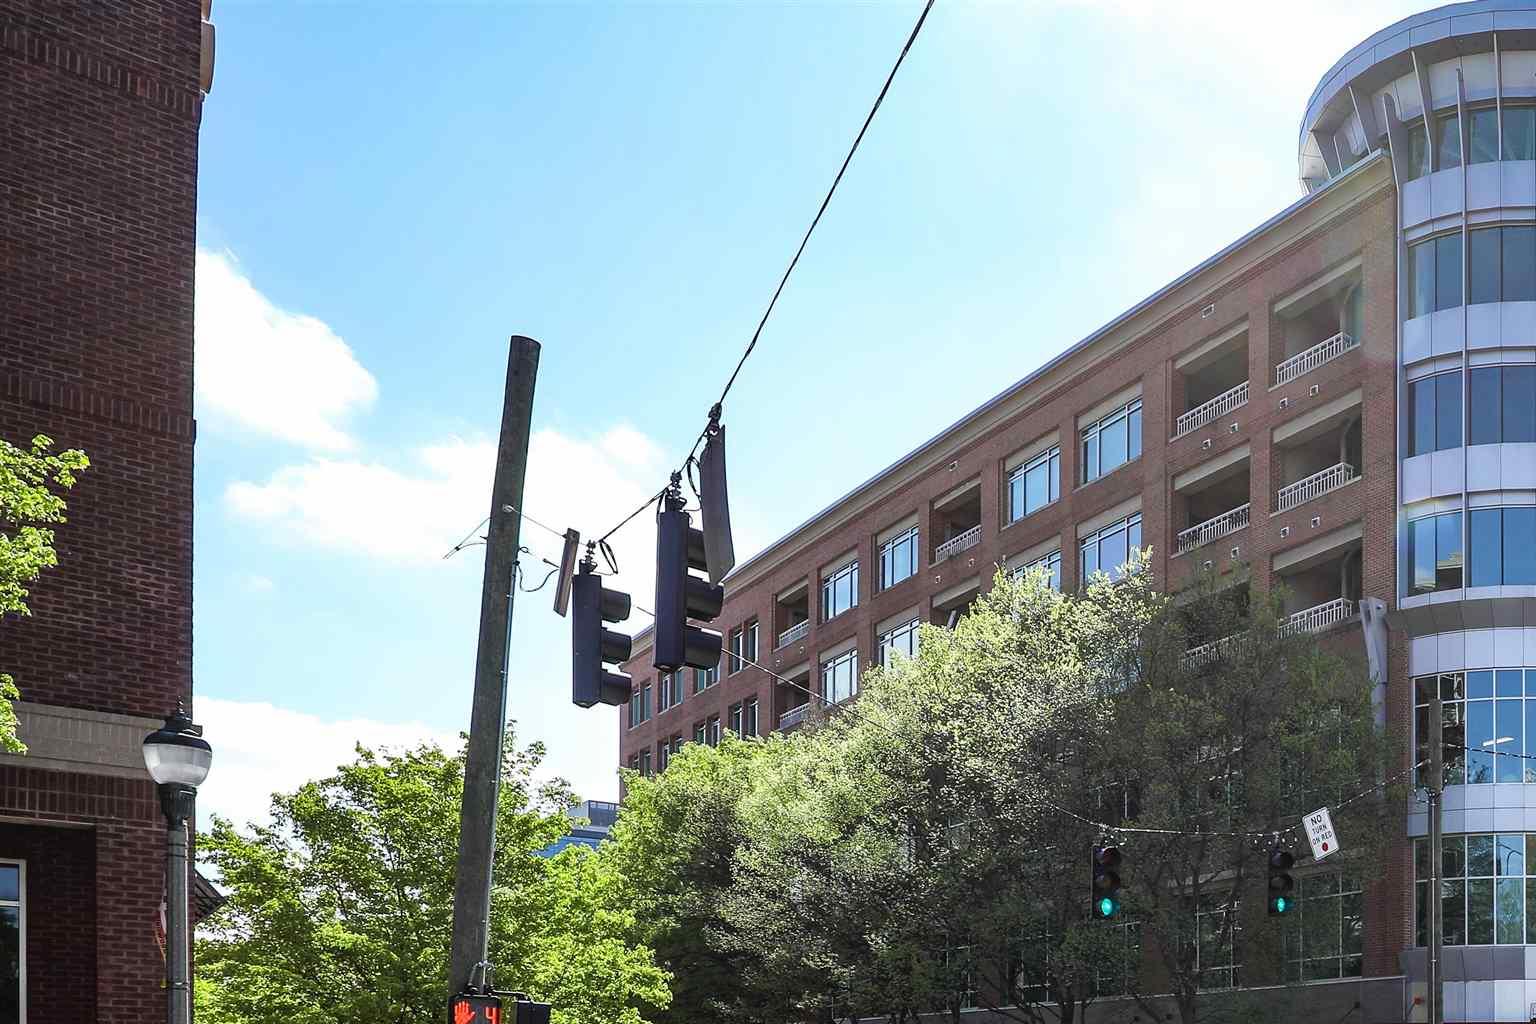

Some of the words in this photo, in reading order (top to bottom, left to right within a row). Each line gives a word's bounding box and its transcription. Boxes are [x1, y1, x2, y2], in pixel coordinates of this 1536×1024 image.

[1310, 815, 1322, 825] NO
[1312, 824, 1327, 834] TURN
[1312, 836, 1321, 846] ON
[1321, 831, 1333, 841] RED
